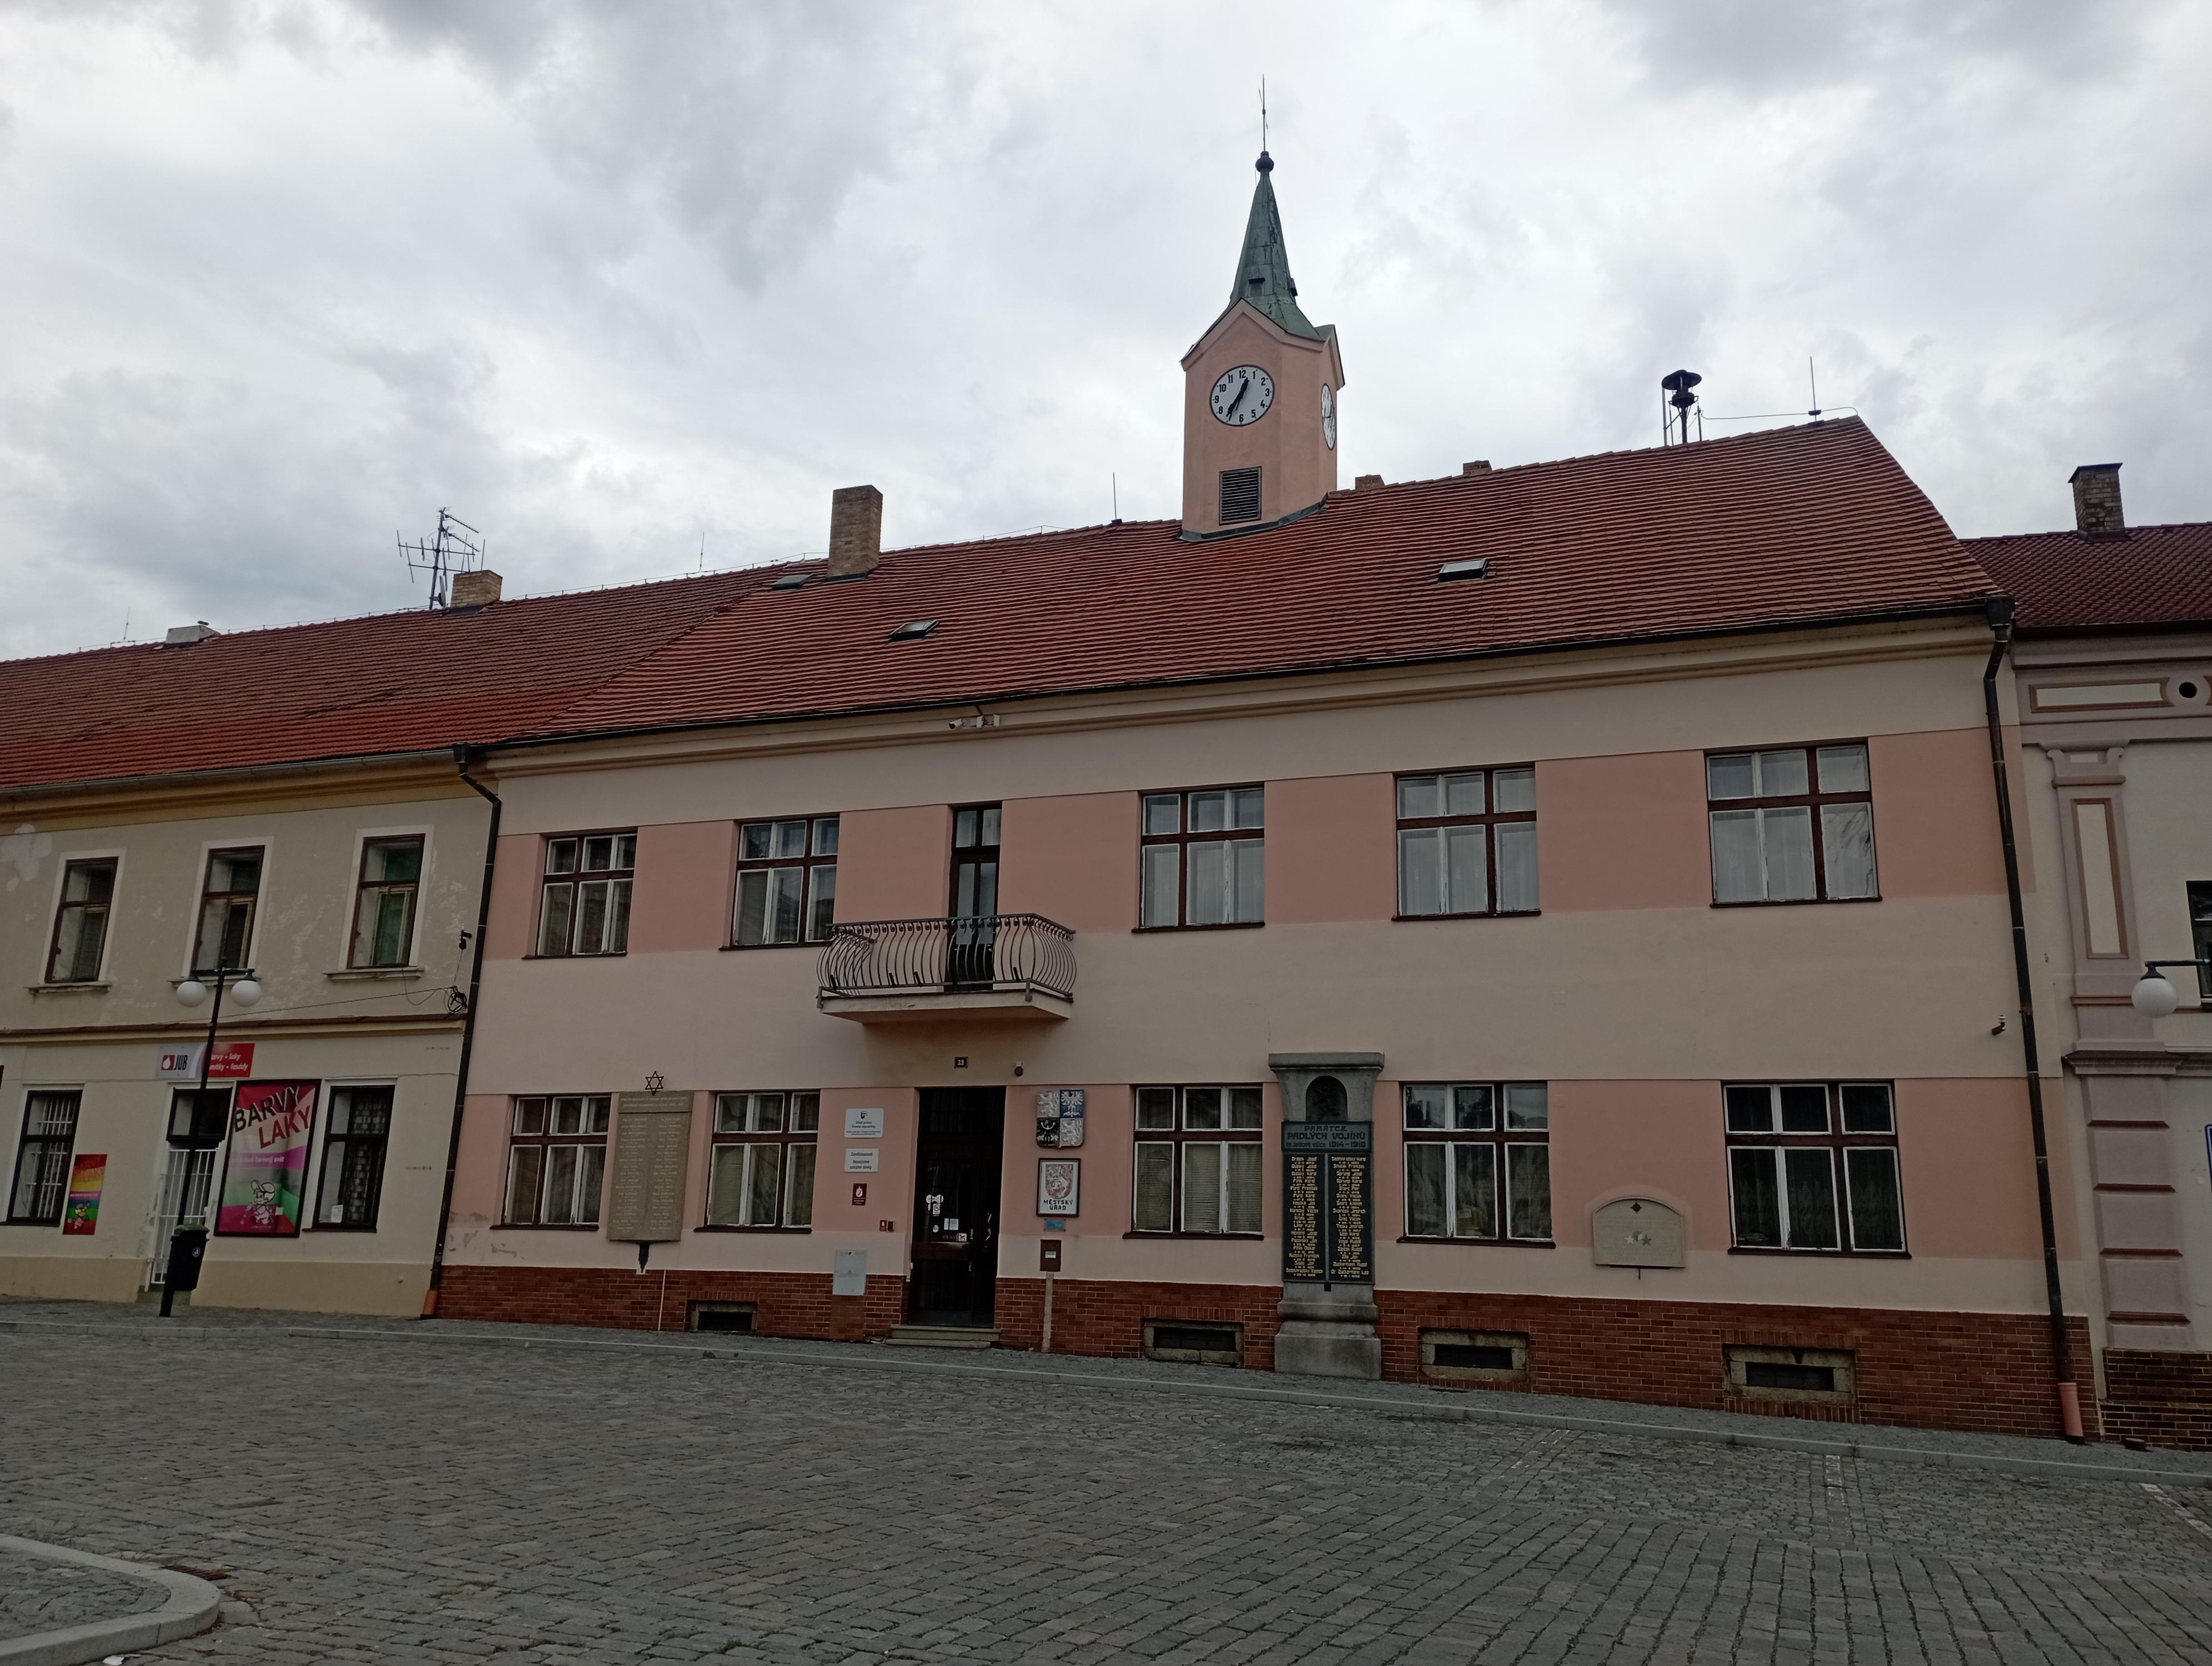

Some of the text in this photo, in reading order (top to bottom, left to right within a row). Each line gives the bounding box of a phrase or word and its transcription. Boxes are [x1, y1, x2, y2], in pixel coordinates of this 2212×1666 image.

[1239, 369, 1246, 379] 12
[1253, 371, 1255, 379] 1
[1228, 374, 1233, 384] 11
[1261, 377, 1266, 386] 2
[1219, 384, 1226, 393] 10
[1265, 388, 1270, 397] 3
[1214, 395, 1219, 404] 9
[1260, 400, 1265, 408] 4
[1218, 406, 1223, 414] 8
[1251, 409, 1256, 418] 5
[173, 1055, 188, 1070] JUB
[234, 1085, 300, 1133] BARVY
[259, 1106, 310, 1148] LAKY
[1287, 1131, 1328, 1140] PADLÝCH
